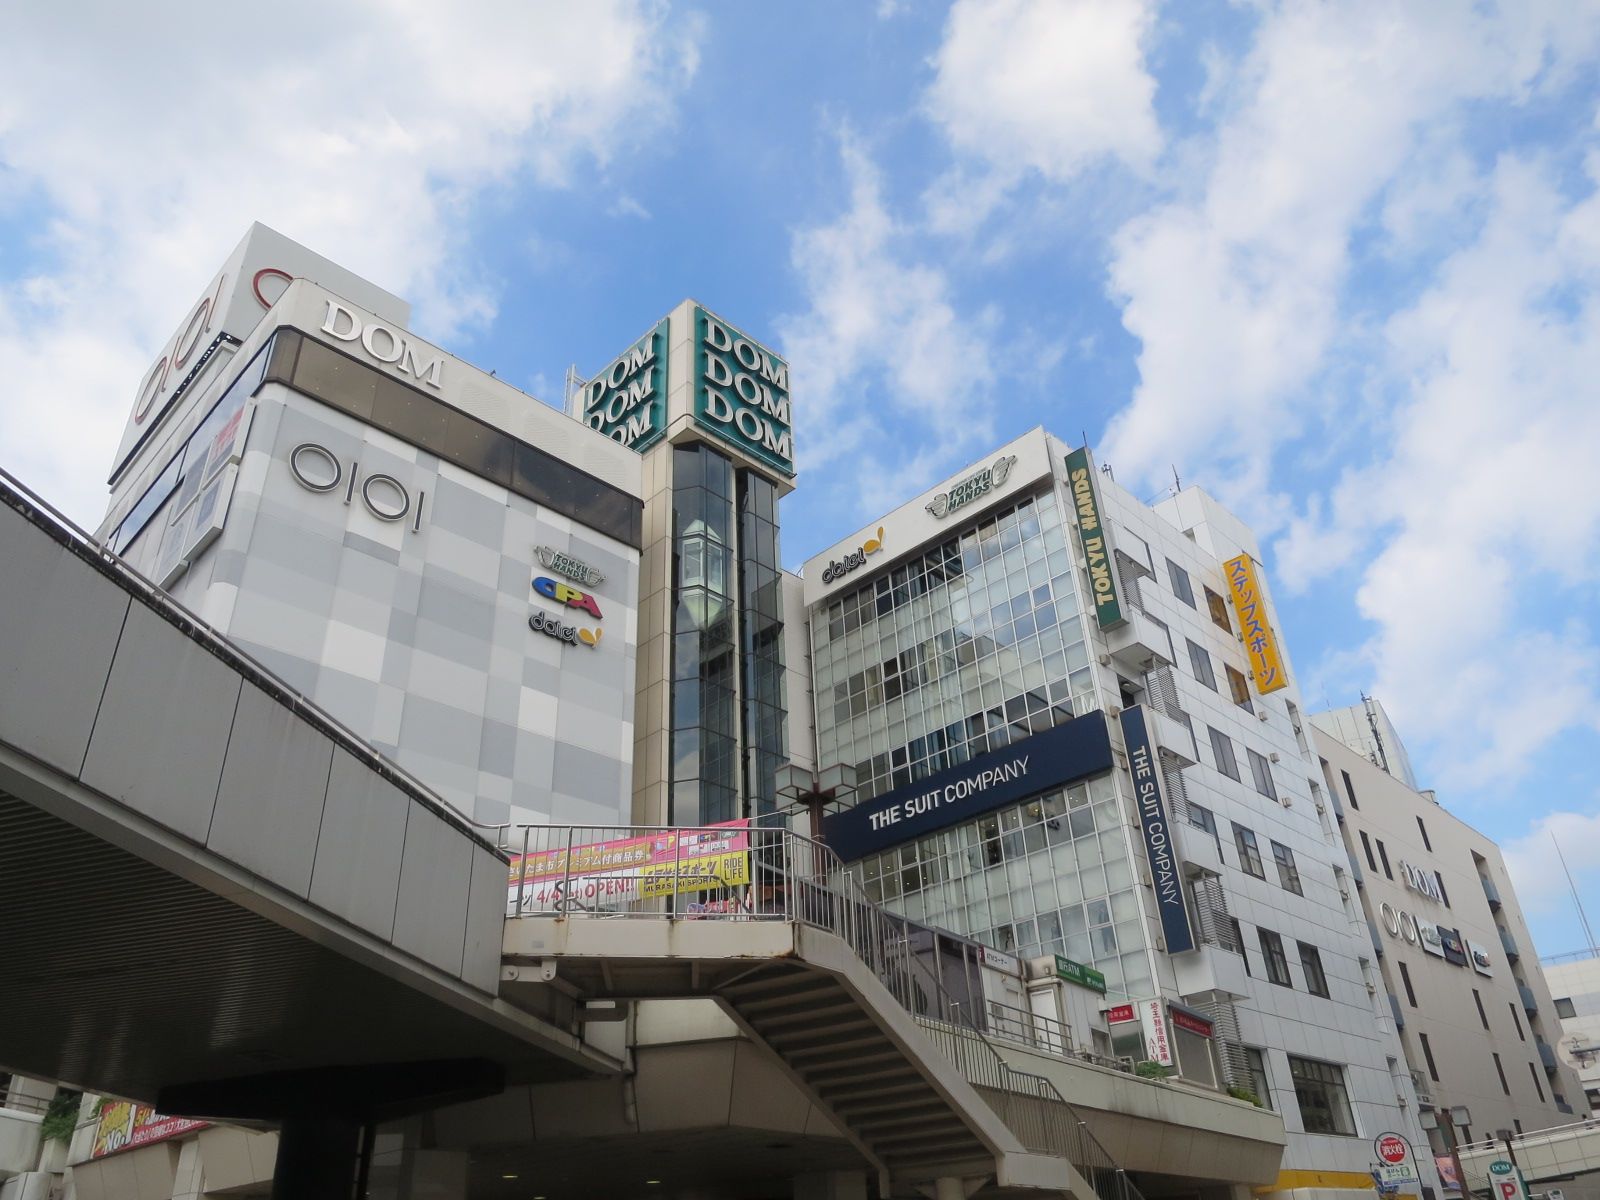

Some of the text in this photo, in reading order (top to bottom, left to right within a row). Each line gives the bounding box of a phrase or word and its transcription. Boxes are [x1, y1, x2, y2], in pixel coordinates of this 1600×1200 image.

[319, 299, 445, 391] DOM
[704, 316, 789, 392] DOM
[585, 332, 657, 412] DOM
[704, 350, 792, 427] DOM
[584, 366, 654, 432] DOM
[704, 384, 792, 462] DOM
[609, 400, 653, 448] OM
[947, 481, 991, 511] HANDS
[948, 469, 991, 500] TOKYU
[1071, 467, 1114, 607] TOKYU HANDS
[553, 561, 587, 581] HANDS
[555, 553, 588, 573] TOKYU
[532, 576, 603, 620] OPA
[1230, 560, 1276, 685] ステップスポーツ
[868, 755, 1029, 831] THE SUIT COMPANY
[1132, 745, 1180, 906] THE SUIT COMPANY
[724, 857, 743, 869] RIDE
[724, 867, 743, 880] LIFE
[1400, 859, 1442, 903] DOM
[584, 878, 634, 898] OPEN!!
[1500, 1182, 1516, 1200] P
